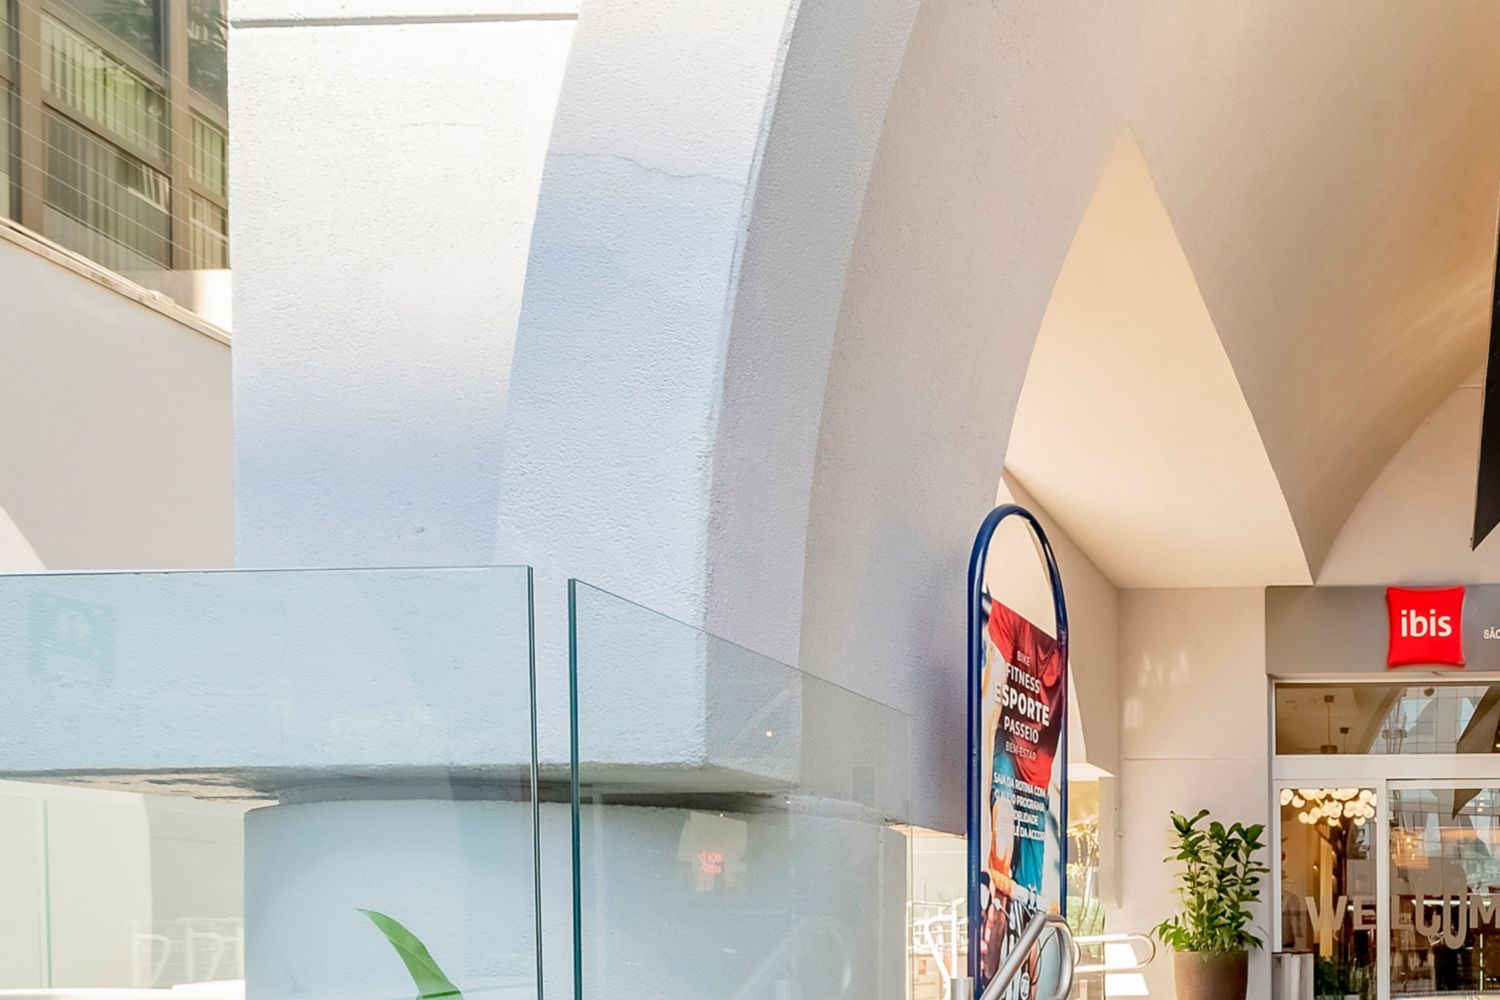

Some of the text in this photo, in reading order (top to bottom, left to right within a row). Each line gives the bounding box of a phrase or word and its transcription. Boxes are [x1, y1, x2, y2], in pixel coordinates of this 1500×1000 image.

[1401, 609, 1452, 637] ibis
[1017, 651, 1031, 666] BIKE
[1006, 663, 1041, 694] FITNESS
[995, 682, 1050, 727] ESPORTE
[1004, 716, 1039, 743] PASSEIO
